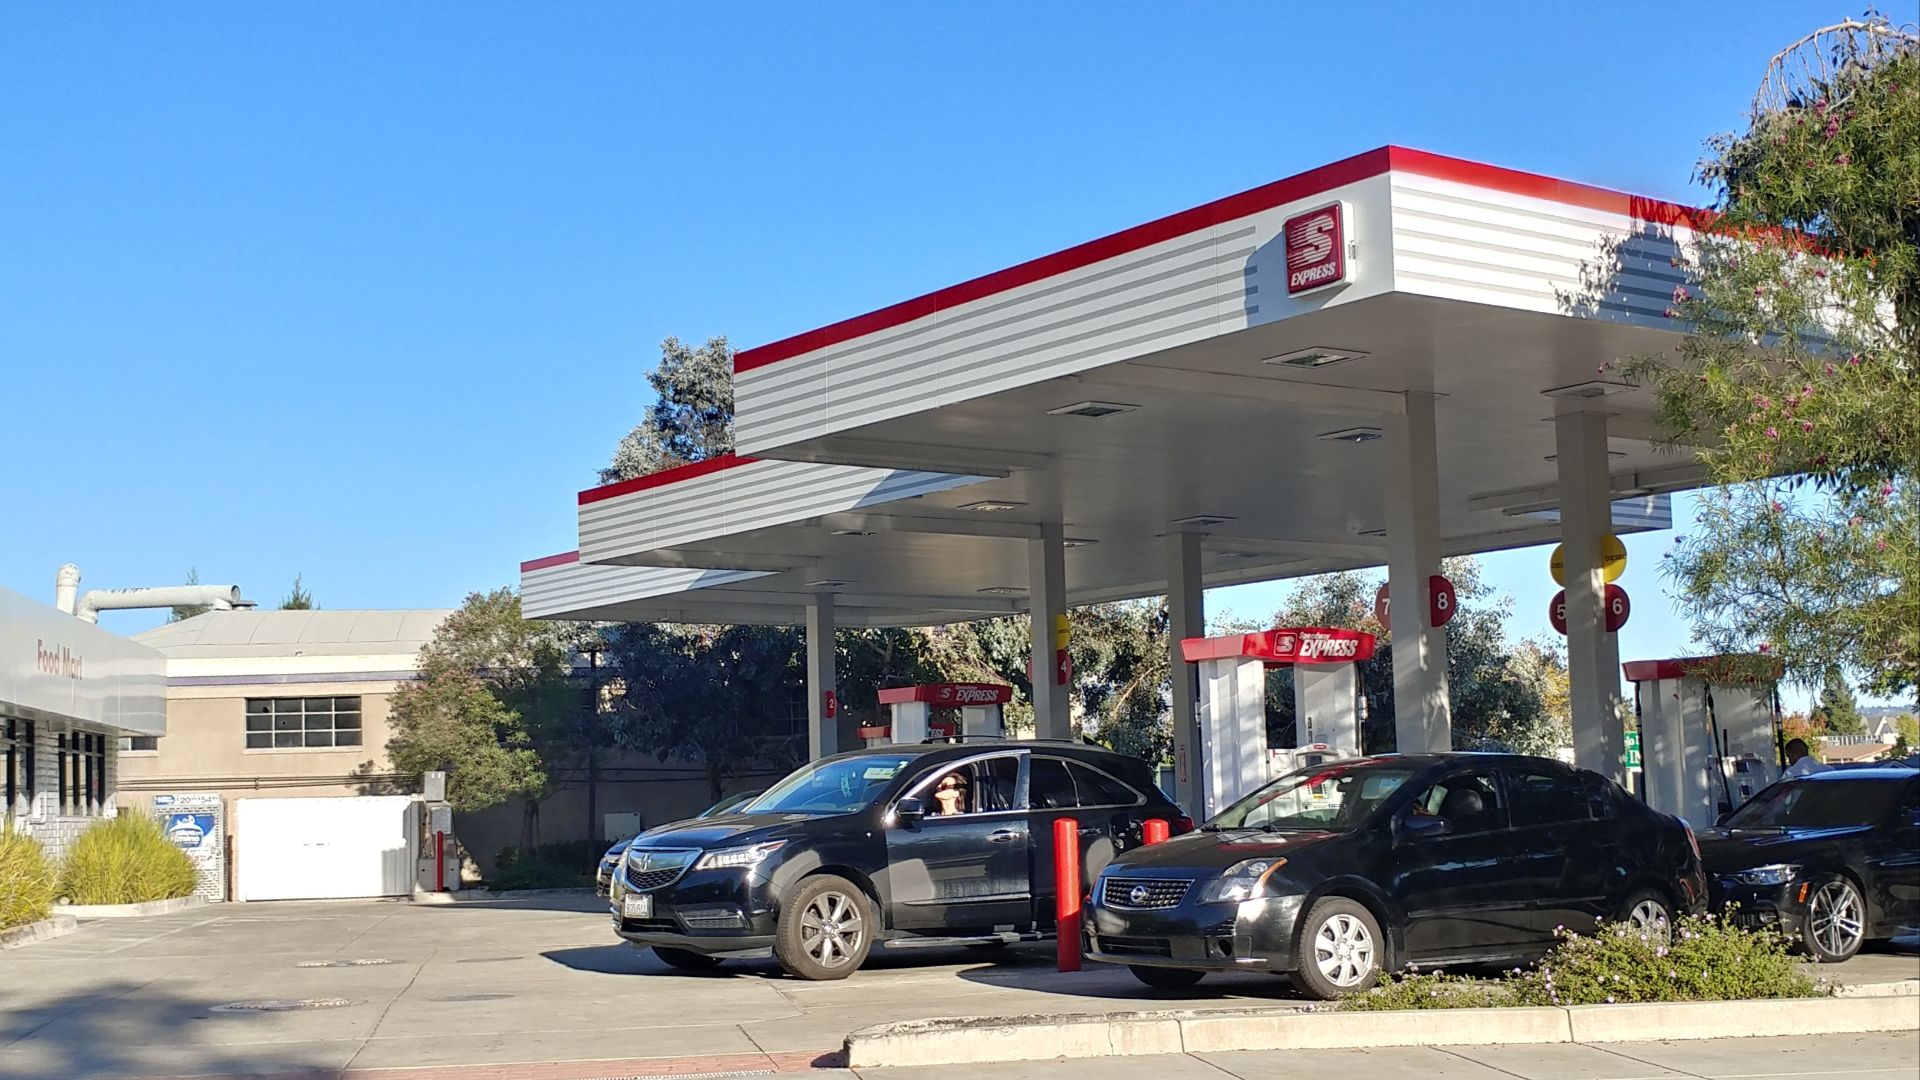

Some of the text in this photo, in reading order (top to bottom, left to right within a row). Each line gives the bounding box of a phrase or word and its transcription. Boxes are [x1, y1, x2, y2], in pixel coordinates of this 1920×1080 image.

[1291, 261, 1336, 287] EXPRESS
[1381, 598, 1391, 616] 7
[1437, 591, 1449, 610] 8
[1612, 597, 1623, 615] 6
[1556, 603, 1566, 620] 5
[37, 638, 60, 675] Food
[1300, 639, 1359, 659] EXPRESS
[1060, 660, 1068, 673] 4
[829, 698, 835, 709] 2
[955, 689, 999, 702] EXPRESS
